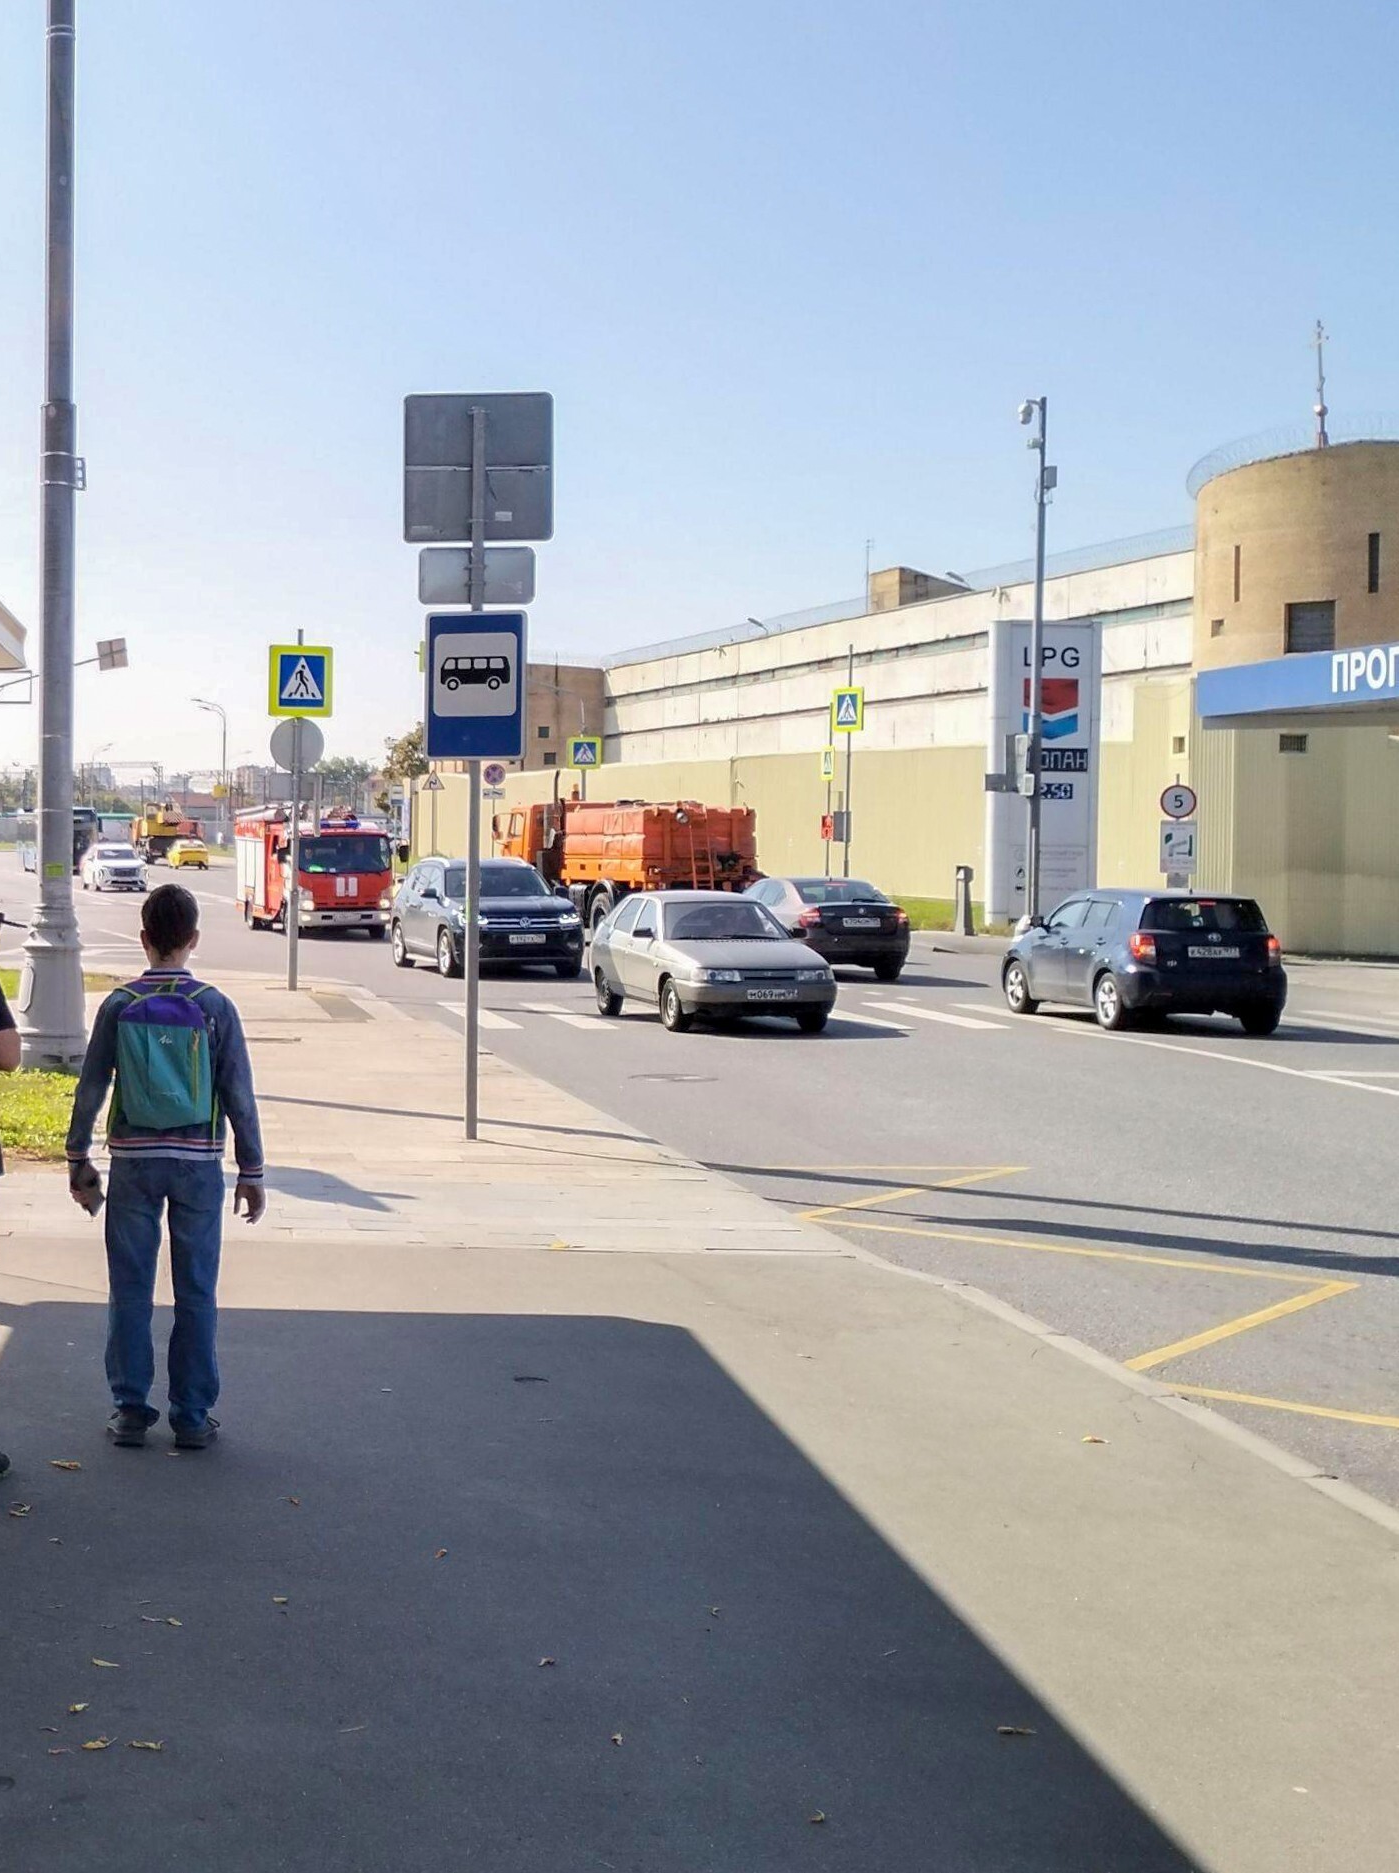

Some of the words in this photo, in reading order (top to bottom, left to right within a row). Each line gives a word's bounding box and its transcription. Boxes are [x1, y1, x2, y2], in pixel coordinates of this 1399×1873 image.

[1024, 646, 1080, 668] LPG
[1027, 751, 1087, 769] ОПАН
[1174, 794, 1184, 809] 5
